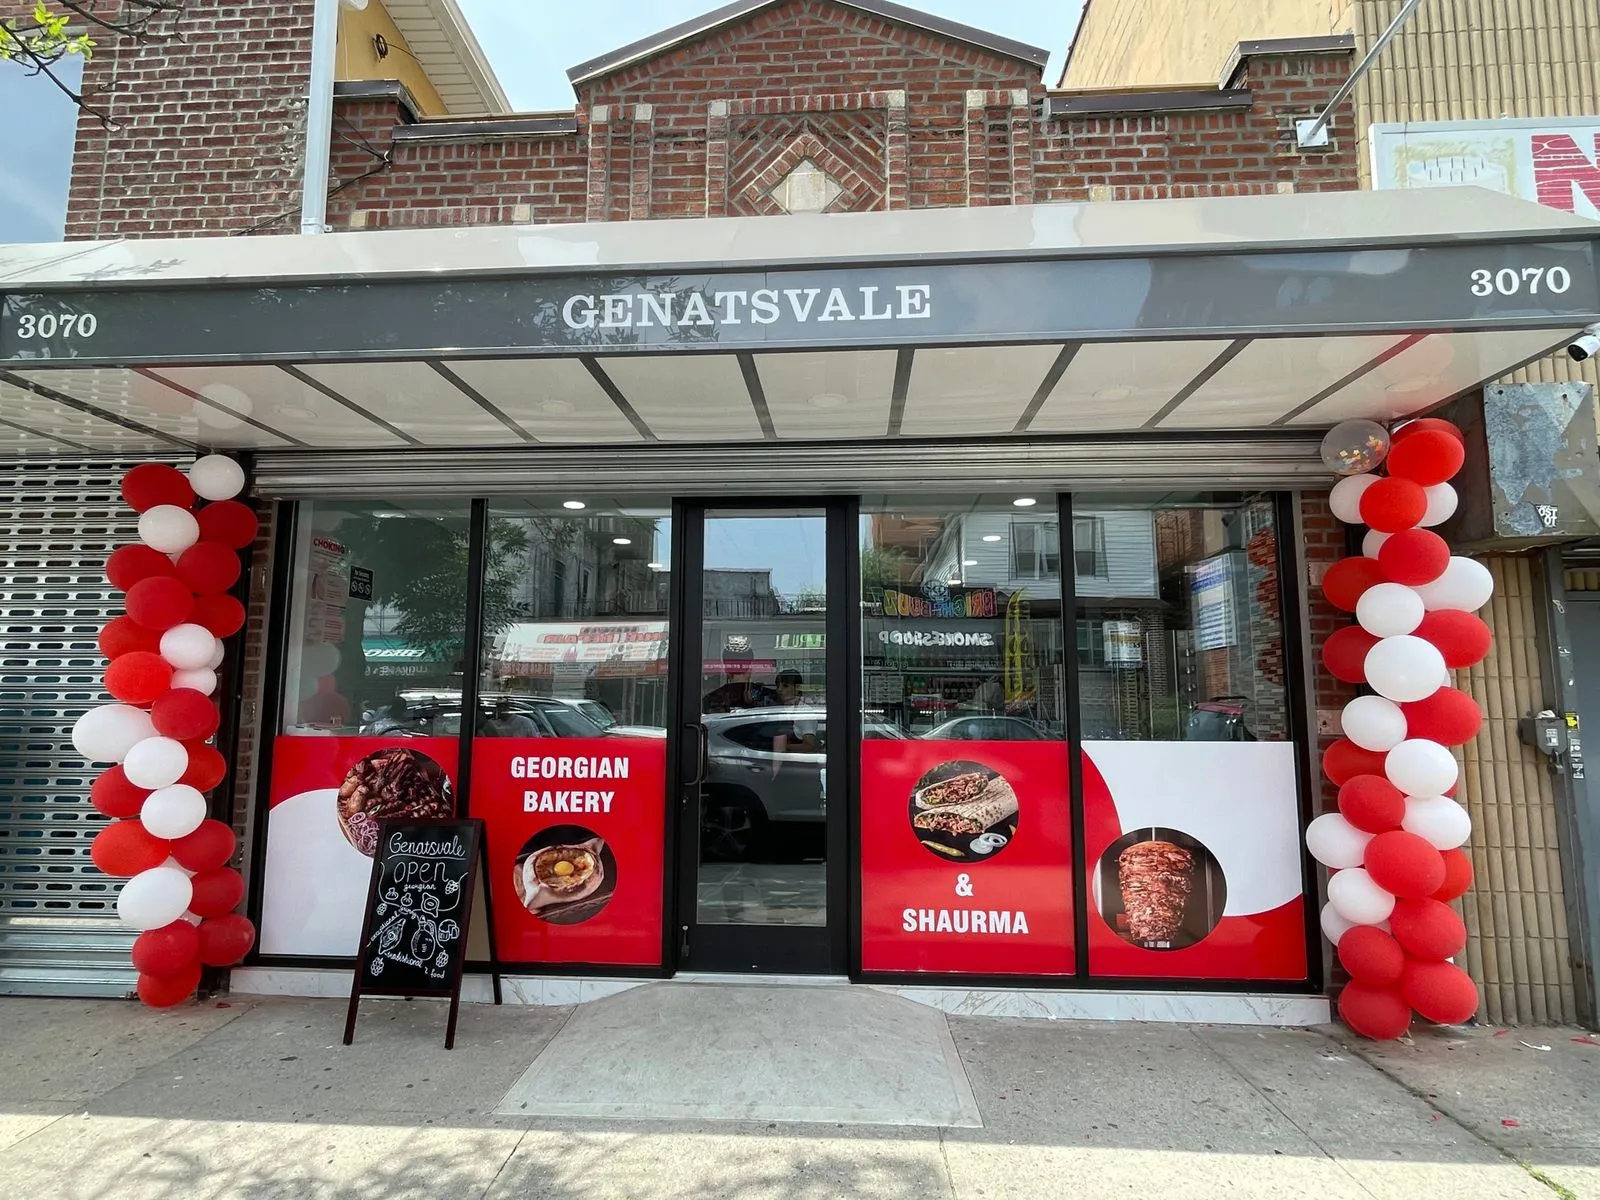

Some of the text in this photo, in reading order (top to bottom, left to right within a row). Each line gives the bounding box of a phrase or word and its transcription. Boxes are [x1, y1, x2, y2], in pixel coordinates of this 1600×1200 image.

[1470, 266, 1571, 297] 3070
[562, 284, 931, 330] GENATSVALE
[17, 313, 97, 339] 3070
[313, 538, 345, 554] CHOKING
[511, 756, 629, 779] GEORGIAN
[524, 790, 615, 813] BAKERY
[389, 832, 466, 857] Genatsvale
[955, 873, 974, 897] &
[902, 908, 1029, 934] SHAURMA
[430, 968, 446, 979] food
